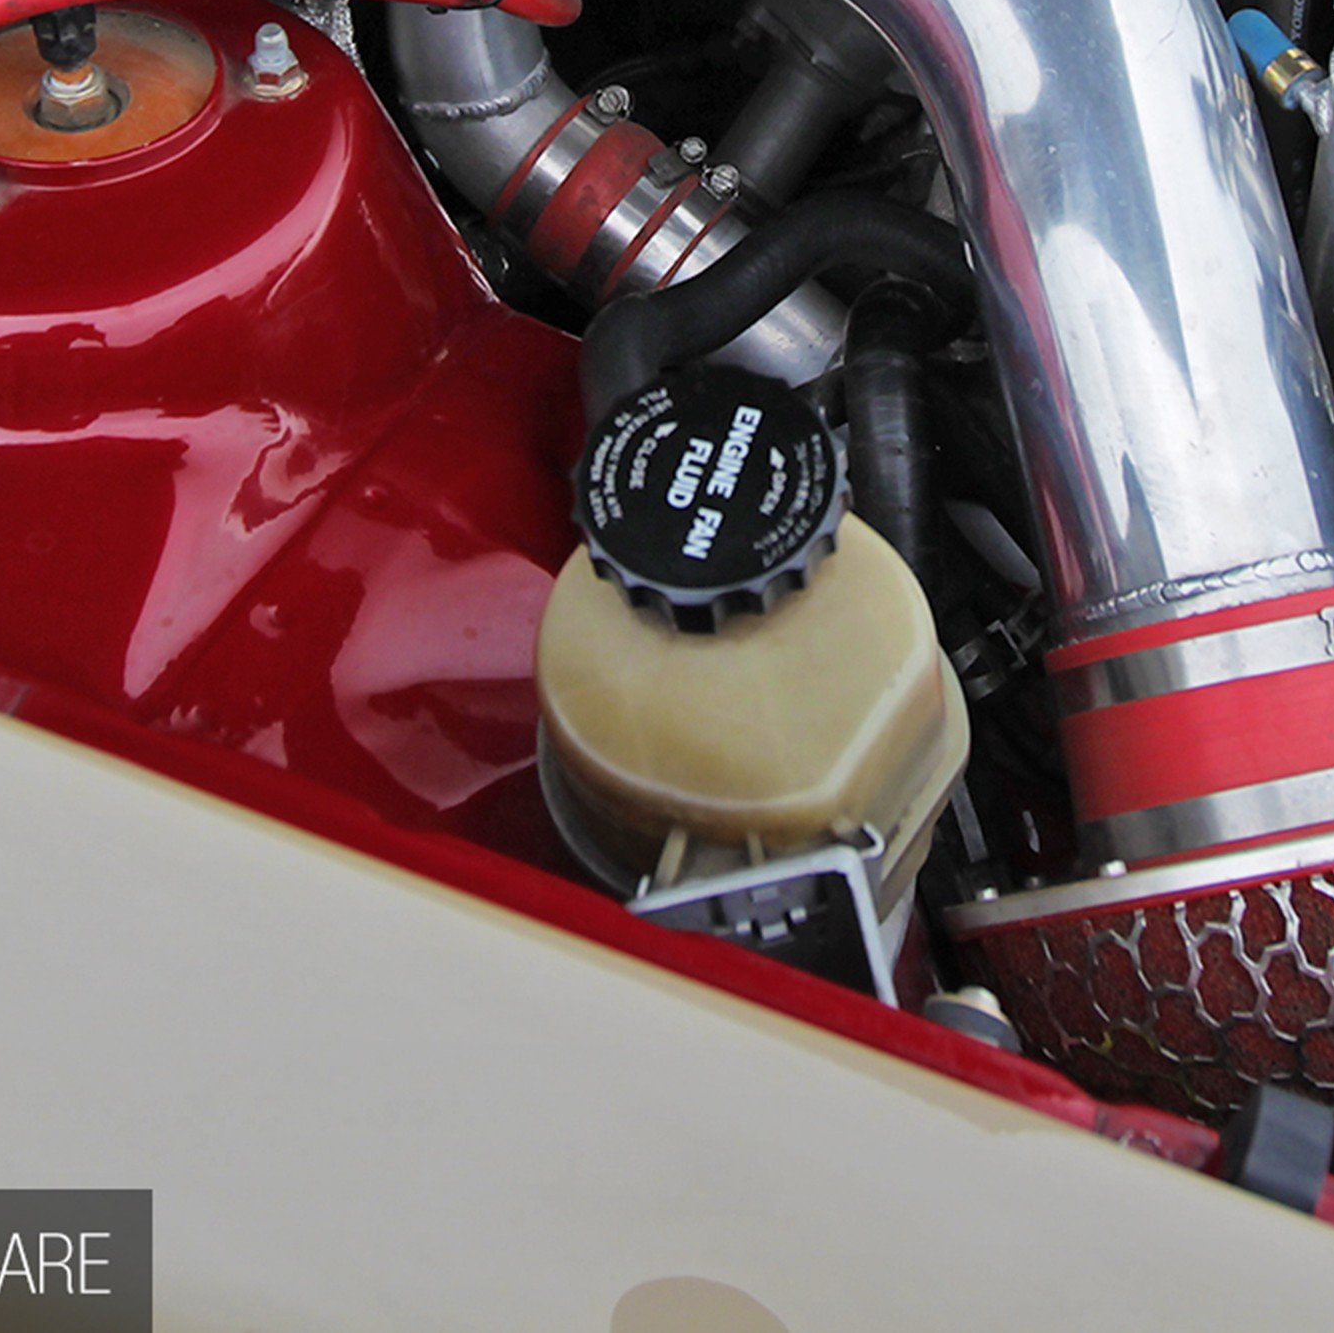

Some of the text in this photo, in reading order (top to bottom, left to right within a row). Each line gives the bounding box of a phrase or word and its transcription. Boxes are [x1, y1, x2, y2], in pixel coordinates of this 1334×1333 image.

[630, 439, 656, 489] CLOSE
[667, 439, 712, 508] FLUID
[683, 406, 762, 559] ENGINE FAN
[760, 472, 787, 515] OPEN
